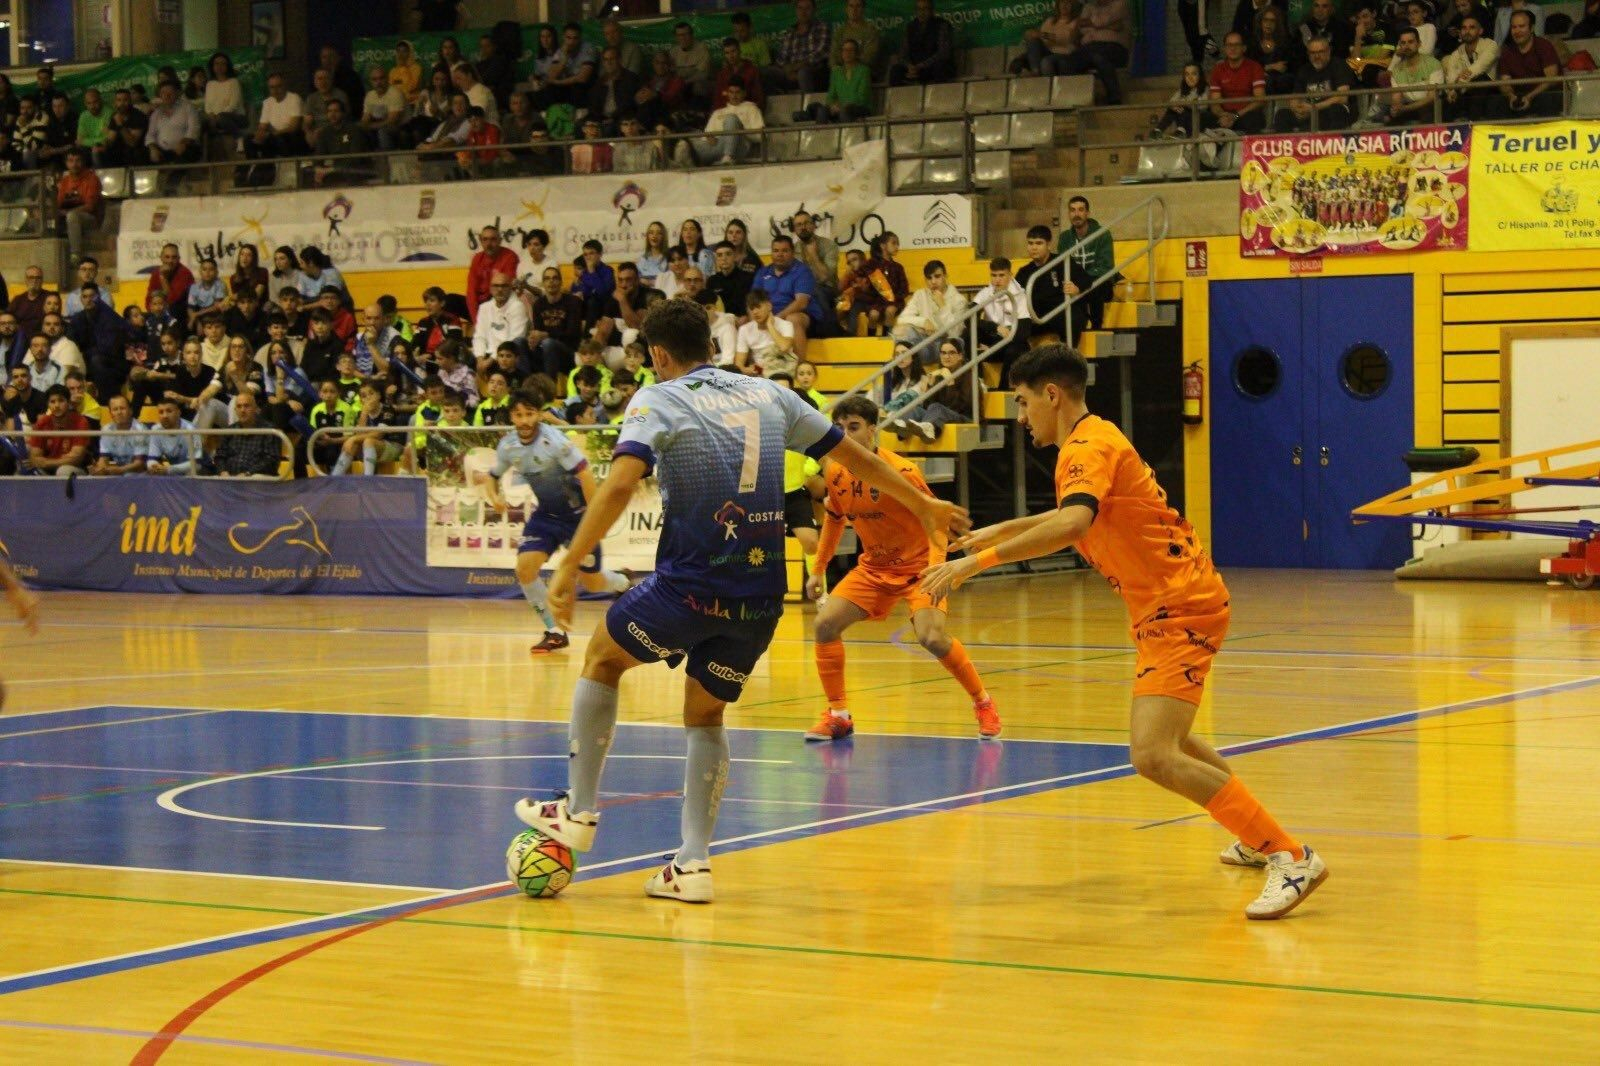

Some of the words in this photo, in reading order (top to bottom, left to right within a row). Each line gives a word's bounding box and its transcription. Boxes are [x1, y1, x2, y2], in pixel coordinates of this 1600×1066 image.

[1251, 139, 1293, 157] CLUB
[1297, 135, 1385, 156] GIMNASIA
[1389, 129, 1463, 151] RÍTMICA
[1488, 129, 1577, 153] Teruel
[1485, 162, 1539, 174] TALLER
[1545, 161, 1563, 172] DE
[912, 235, 969, 247] CITROËN
[721, 408, 760, 493] 7
[851, 480, 862, 497] 14
[120, 502, 203, 557] imd
[177, 564, 233, 580] Municipal
[235, 566, 248, 578] de
[251, 565, 297, 581] Deportes
[300, 564, 313, 578] de
[316, 563, 331, 577] El
[466, 571, 516, 586] Instituto
